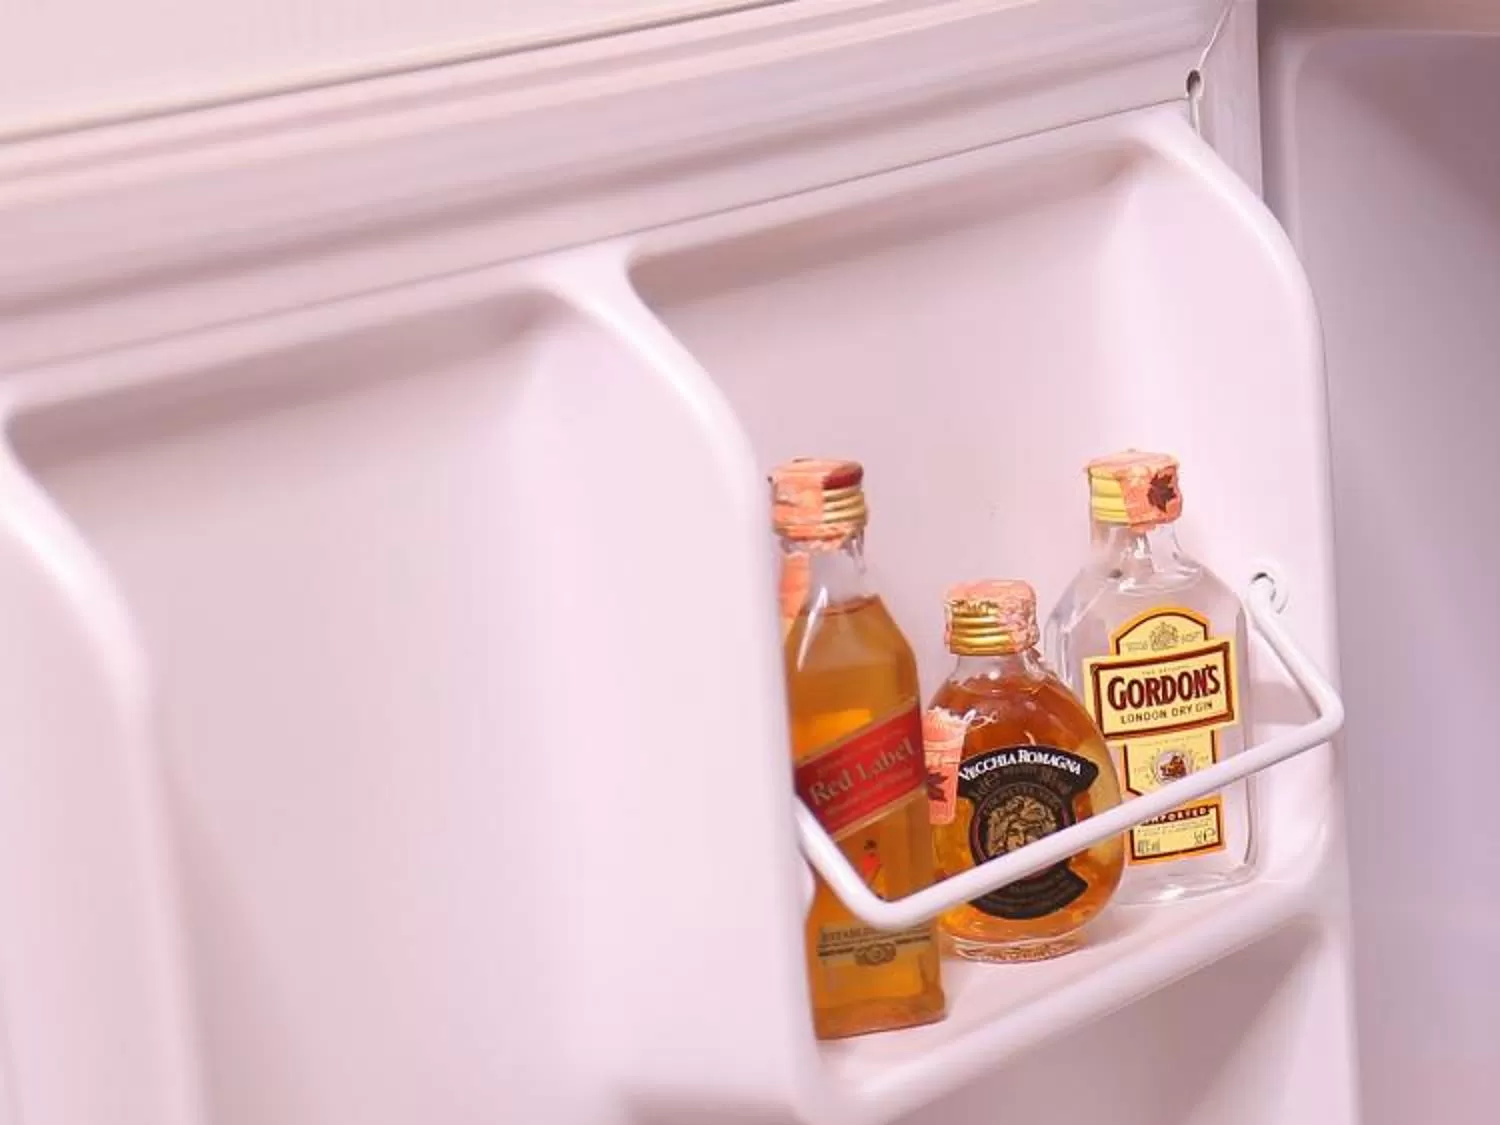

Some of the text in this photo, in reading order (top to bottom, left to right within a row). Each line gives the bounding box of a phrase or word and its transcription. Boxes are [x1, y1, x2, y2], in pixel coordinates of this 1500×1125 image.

[1107, 664, 1221, 711] GORDON'S
[1120, 701, 1213, 725] LONDON DRY GIN
[959, 752, 1017, 781] VECCHIA
[1018, 750, 1081, 776] ROMAGNA
[809, 768, 854, 806] Red
